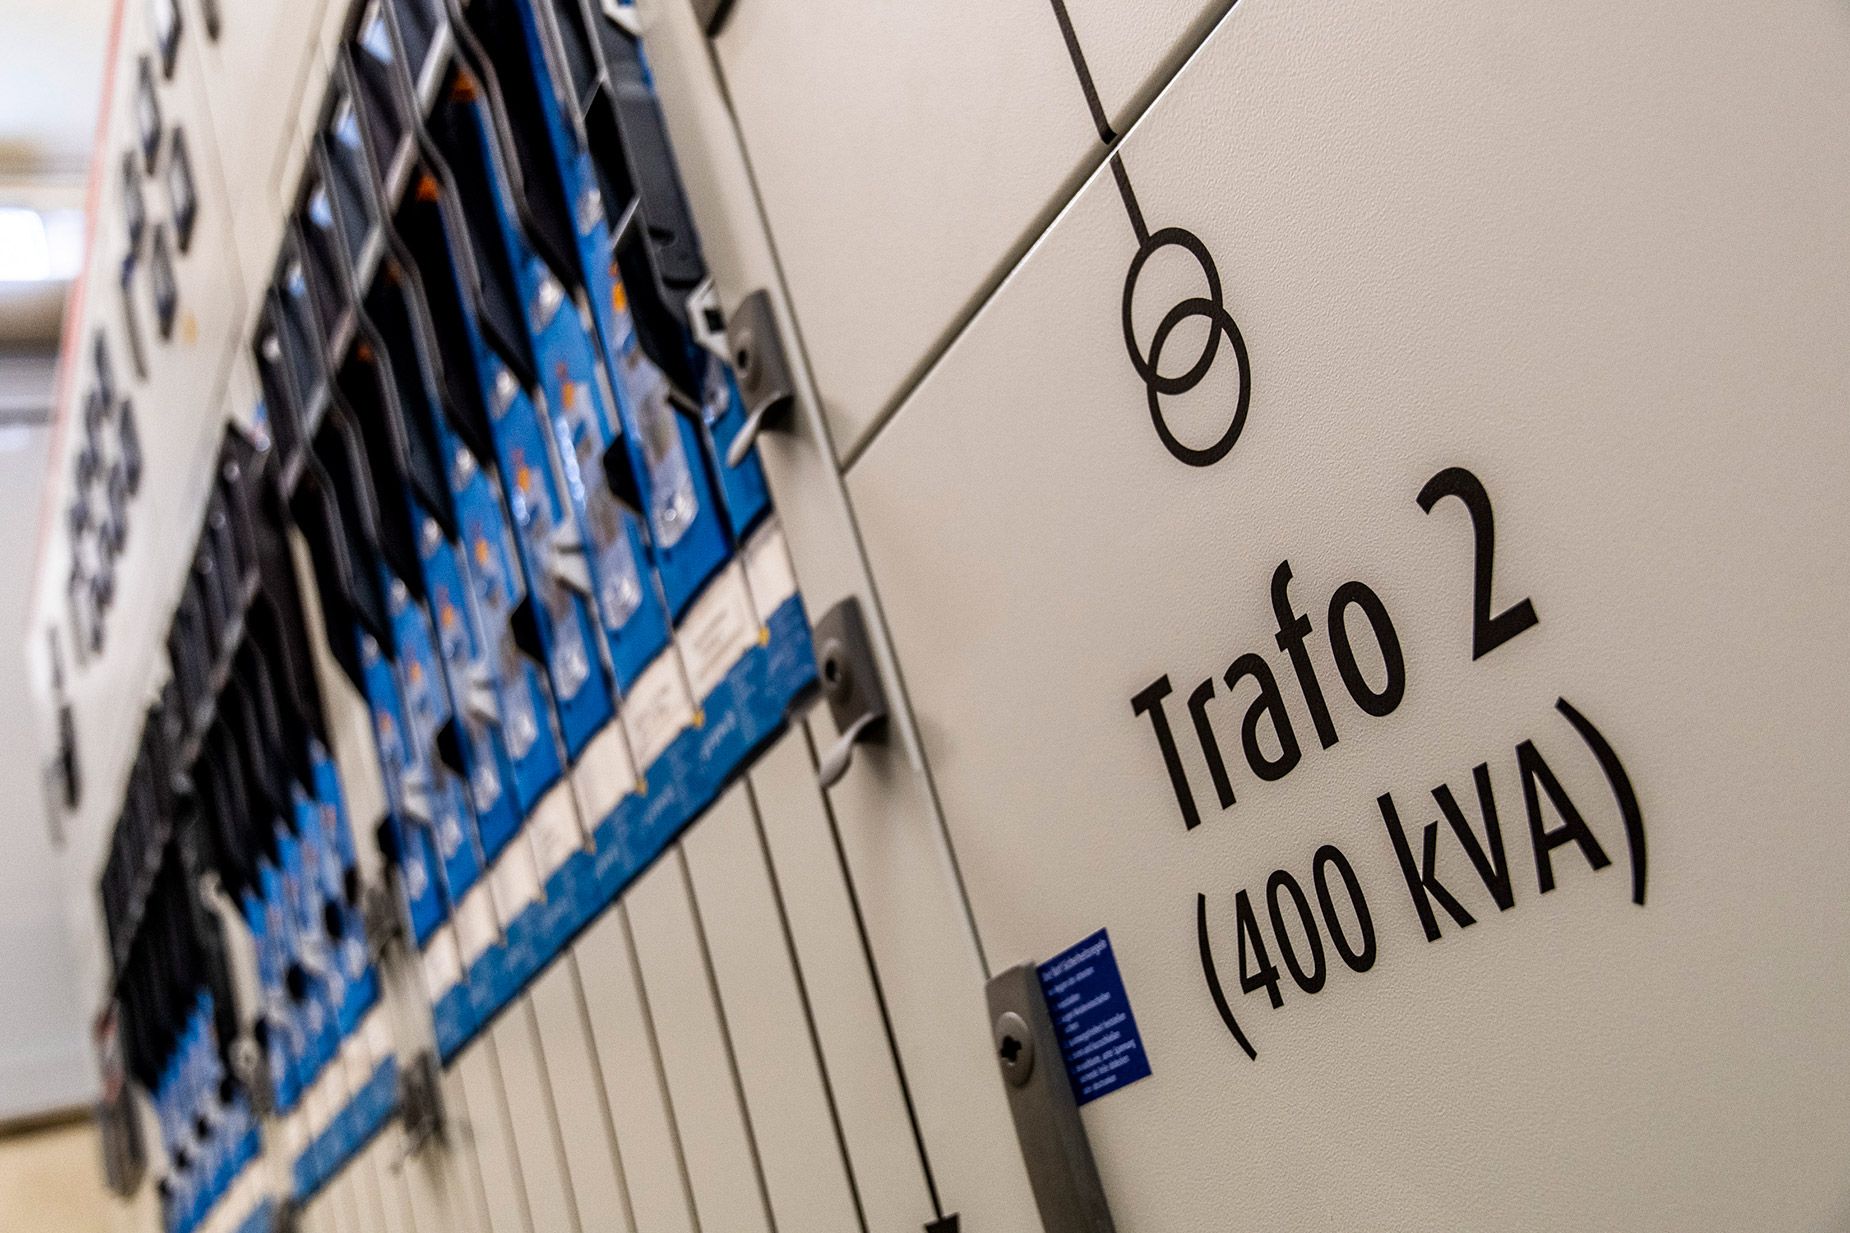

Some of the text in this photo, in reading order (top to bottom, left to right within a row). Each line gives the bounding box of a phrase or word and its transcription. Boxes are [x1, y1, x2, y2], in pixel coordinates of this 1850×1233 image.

[1130, 467, 1539, 831] Trafo 2
[1197, 845, 1377, 1061] (400
[1377, 697, 1648, 943] kVA)
